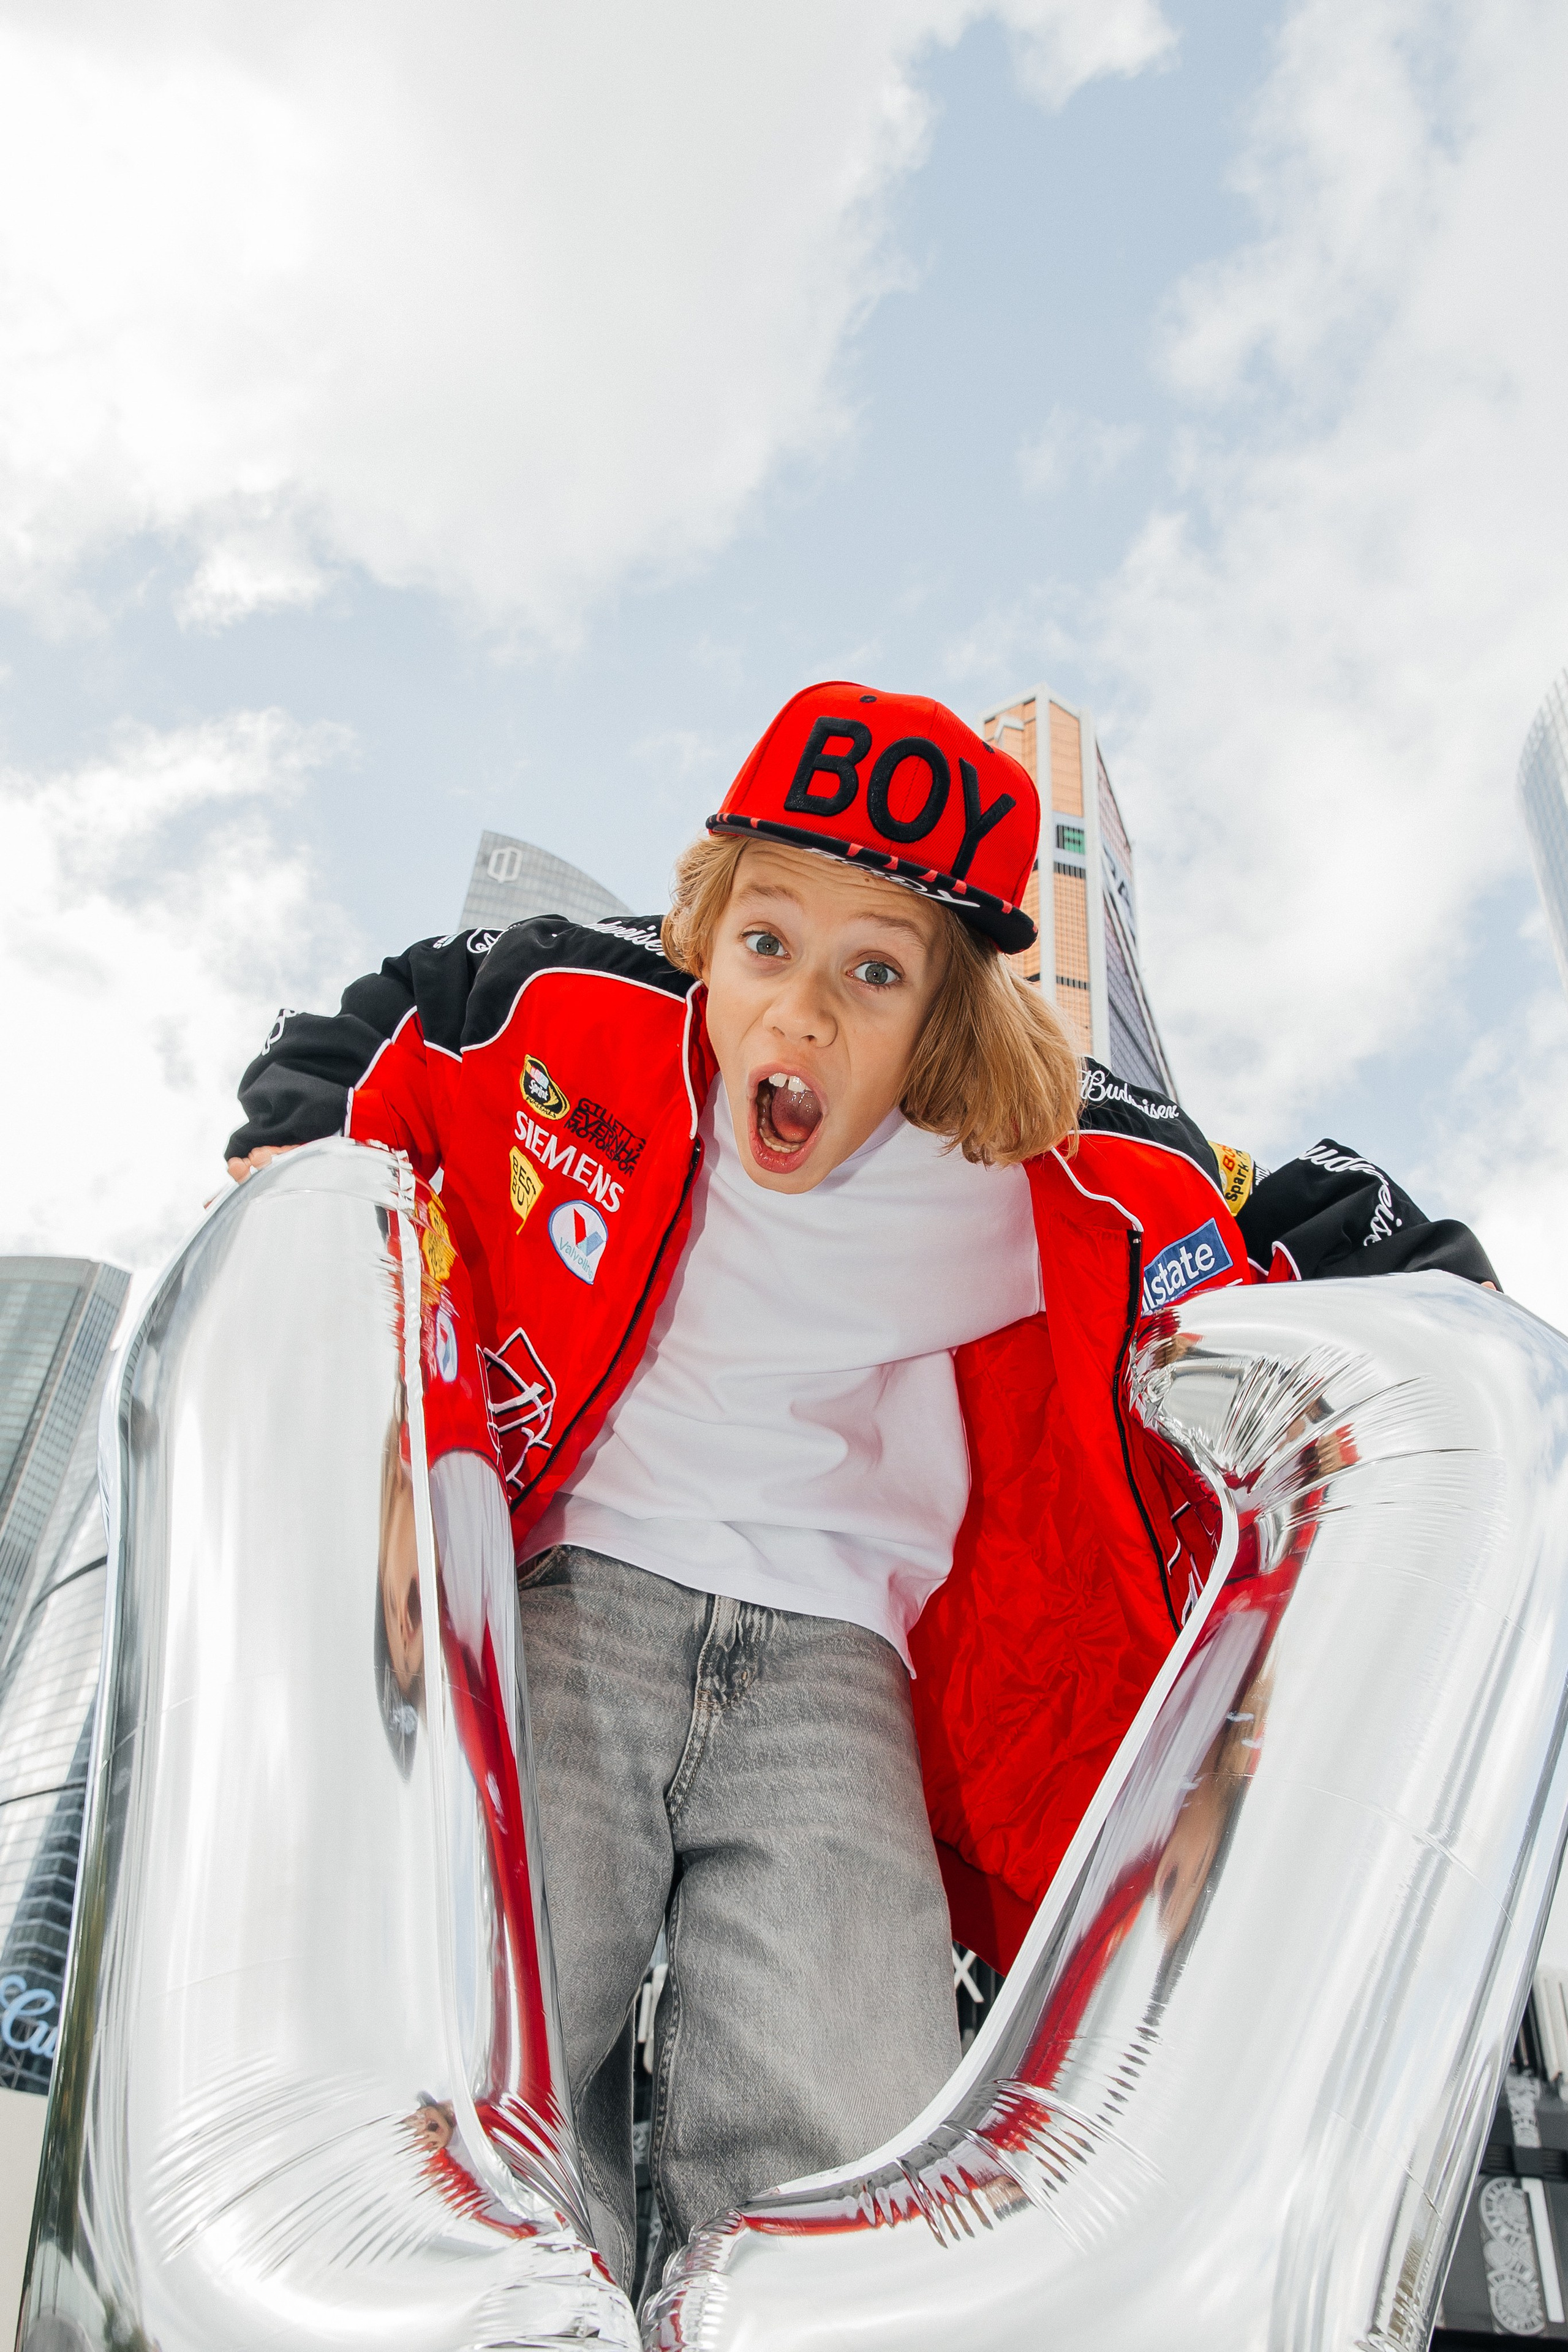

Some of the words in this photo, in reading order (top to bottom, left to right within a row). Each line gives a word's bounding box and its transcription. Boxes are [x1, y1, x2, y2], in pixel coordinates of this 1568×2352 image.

[784, 715, 1017, 881] BOY
[513, 1155, 537, 1196] BEST
[514, 1110, 625, 1213] SIEMENS
[1225, 1161, 1249, 1202] Spark
[511, 1177, 535, 1216] BUY
